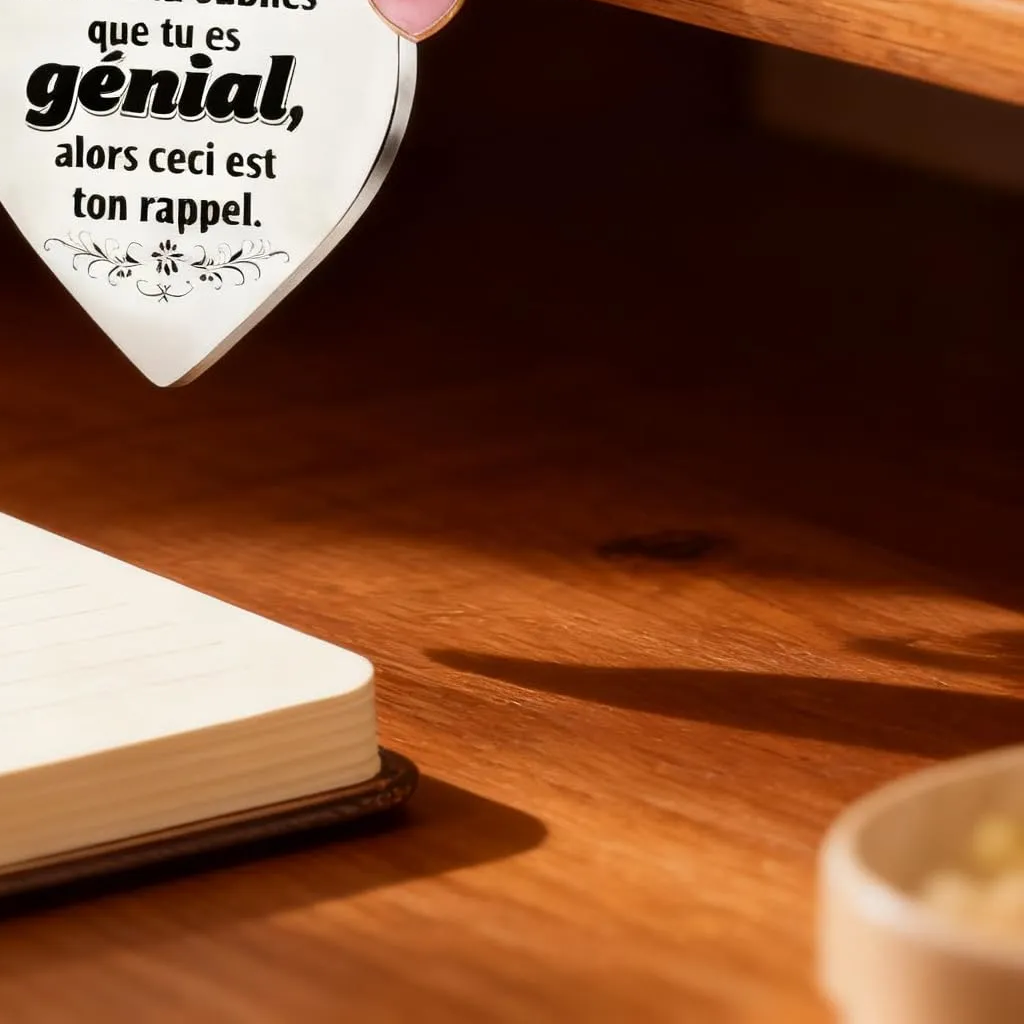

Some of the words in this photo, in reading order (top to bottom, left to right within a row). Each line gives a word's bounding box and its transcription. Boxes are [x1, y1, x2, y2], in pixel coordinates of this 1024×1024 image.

[87, 20, 149, 54] que
[161, 18, 194, 49] tu
[205, 26, 241, 52] es
[25, 50, 304, 133] génial,
[54, 135, 138, 173] alors
[148, 141, 215, 177] ceci
[226, 149, 277, 179] est
[73, 187, 127, 222] ton
[139, 192, 262, 235] rappel.
